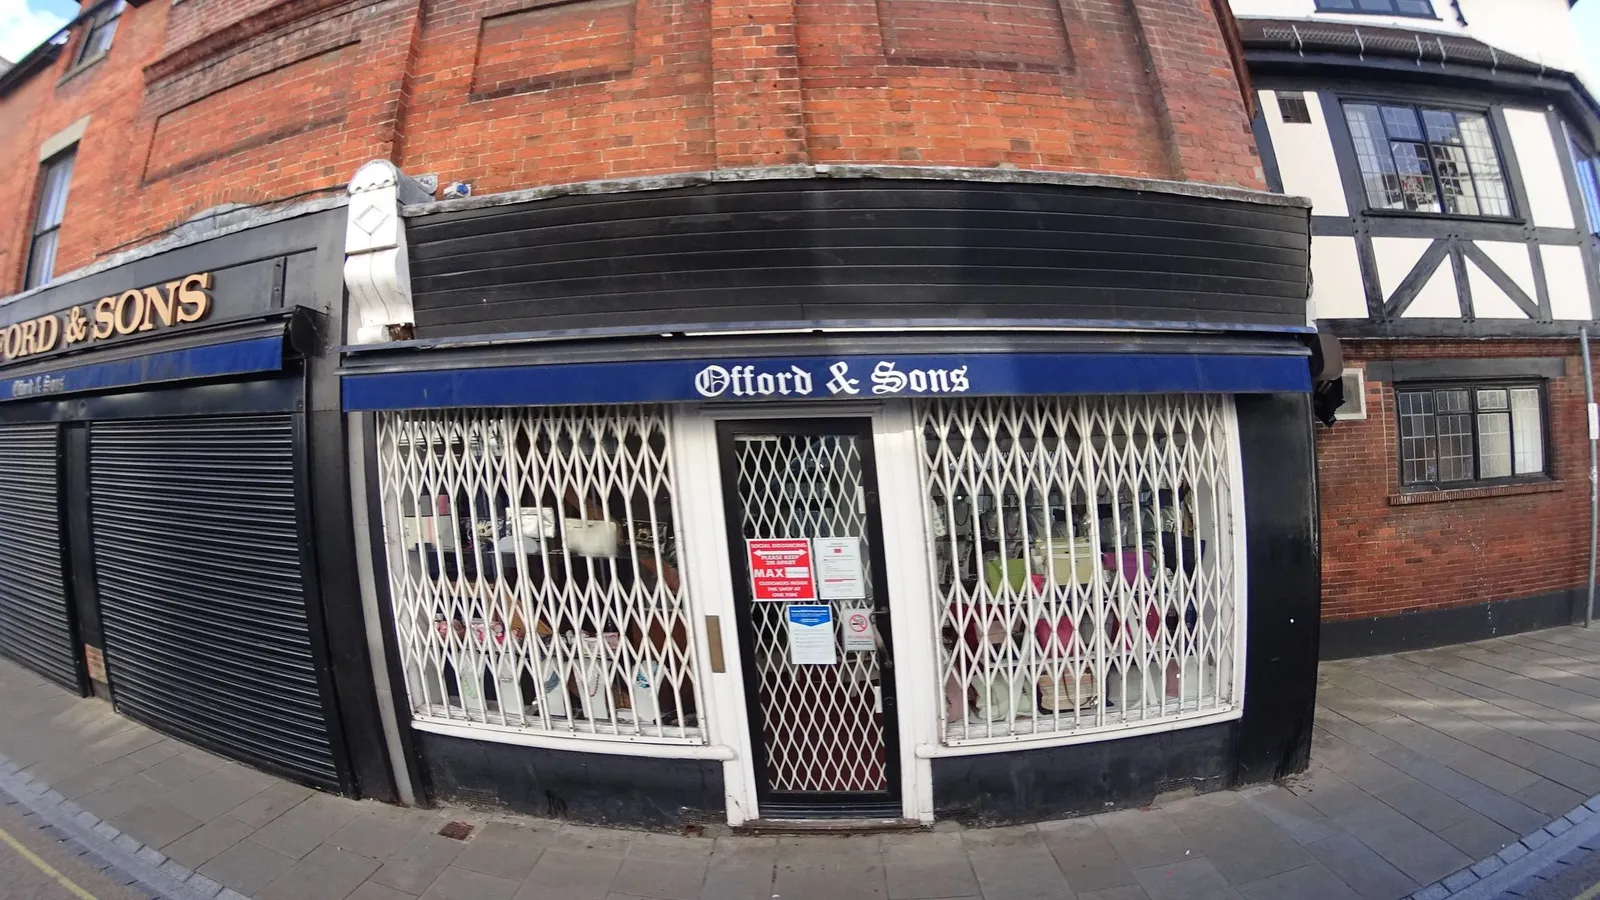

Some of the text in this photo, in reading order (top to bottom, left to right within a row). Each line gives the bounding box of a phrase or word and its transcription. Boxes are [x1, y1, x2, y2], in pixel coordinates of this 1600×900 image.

[66, 306, 86, 344] &
[93, 272, 212, 340] SONS
[695, 360, 970, 398] Offord & Sons
[754, 568, 785, 578] MAX
